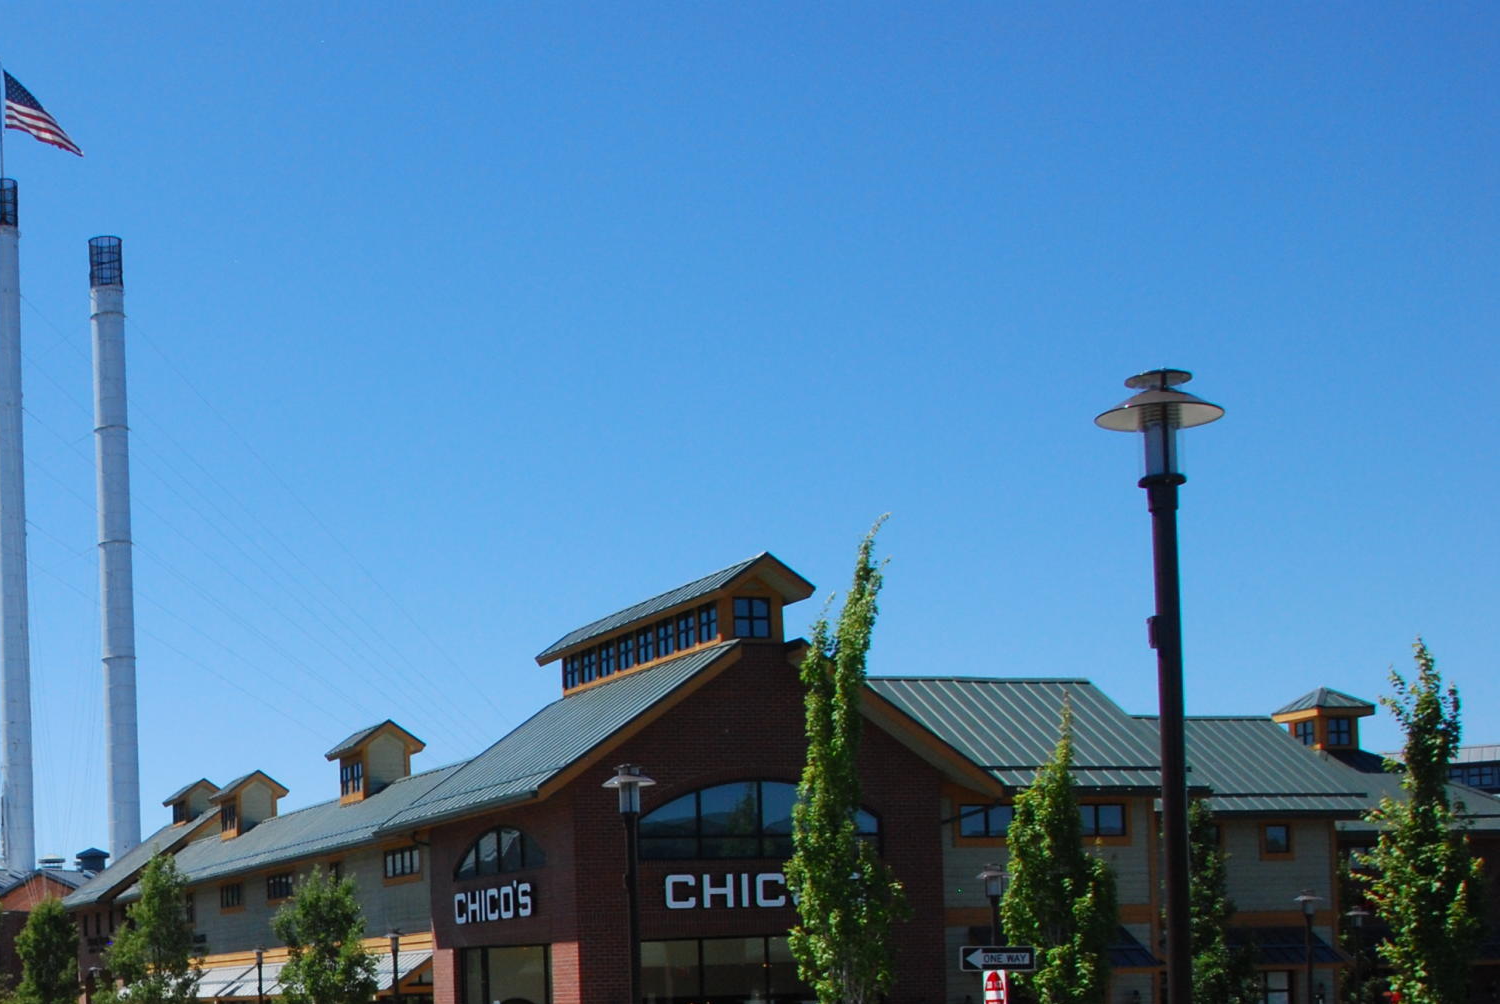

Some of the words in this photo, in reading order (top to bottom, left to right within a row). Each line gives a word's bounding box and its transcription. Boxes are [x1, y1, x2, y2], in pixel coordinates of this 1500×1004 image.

[453, 880, 532, 925] CHICO'S
[664, 873, 800, 909] CHIC
[983, 953, 1003, 963] ONE
[1005, 953, 1027, 963] WAY
